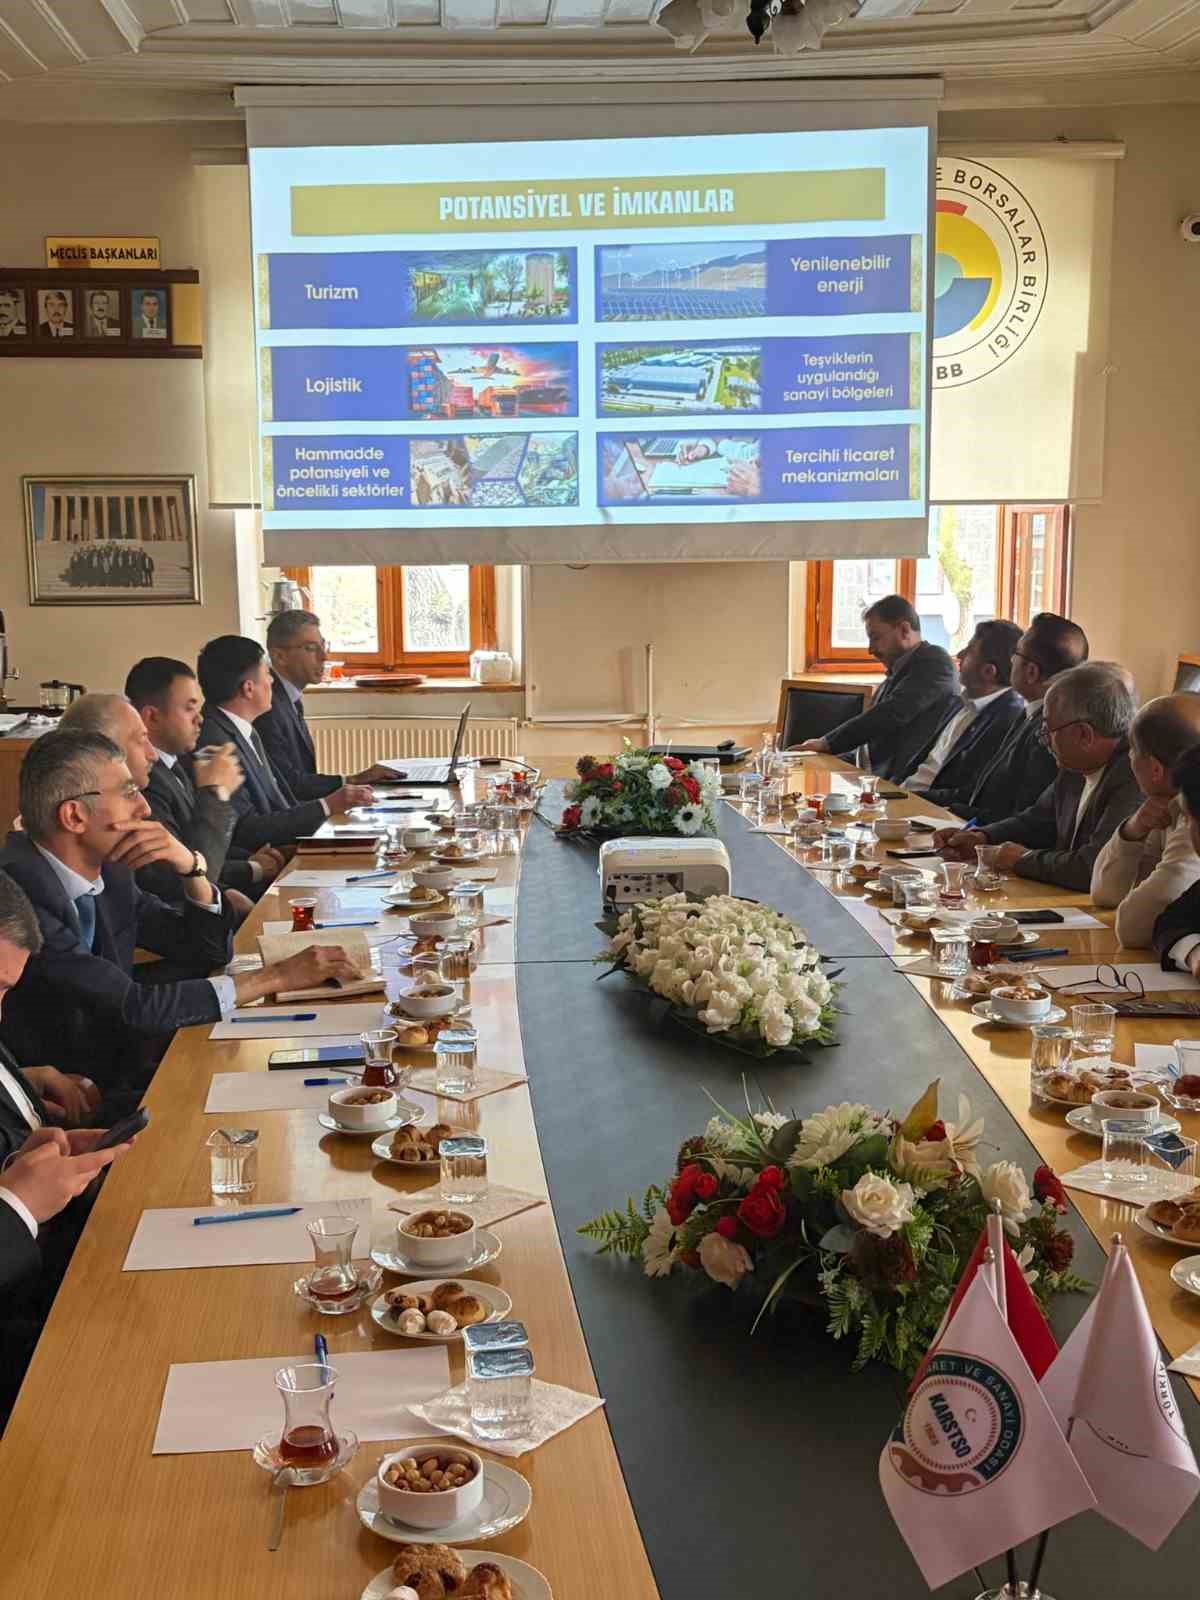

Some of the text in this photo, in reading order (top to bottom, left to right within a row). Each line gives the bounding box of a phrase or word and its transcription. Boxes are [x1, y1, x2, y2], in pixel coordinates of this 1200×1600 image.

[439, 186, 735, 221] POTANSİYEL VE İMKANLAR
[953, 169, 1036, 264] BORSALAR
[50, 244, 157, 262] MECLİS BAŞKANLARI
[790, 254, 892, 273] Yenilenebilir
[304, 284, 359, 300] Turizm
[817, 278, 864, 296] enerji
[988, 275, 1038, 358] BİRLİĞİ
[803, 352, 873, 369] Teşviklerin
[797, 370, 879, 386] uygulandığı
[937, 363, 963, 380] BB
[306, 377, 362, 396] Lojistik
[783, 385, 894, 402] sanayi bölgeleri
[295, 448, 384, 461] Hammadde
[785, 447, 895, 463] Tercihli ticaret
[289, 465, 390, 481] potansiyeli ve
[782, 468, 899, 485] mekanizmaları
[277, 483, 404, 498] öncelikli sektörler
[928, 1392, 972, 1458] KARSTSO
